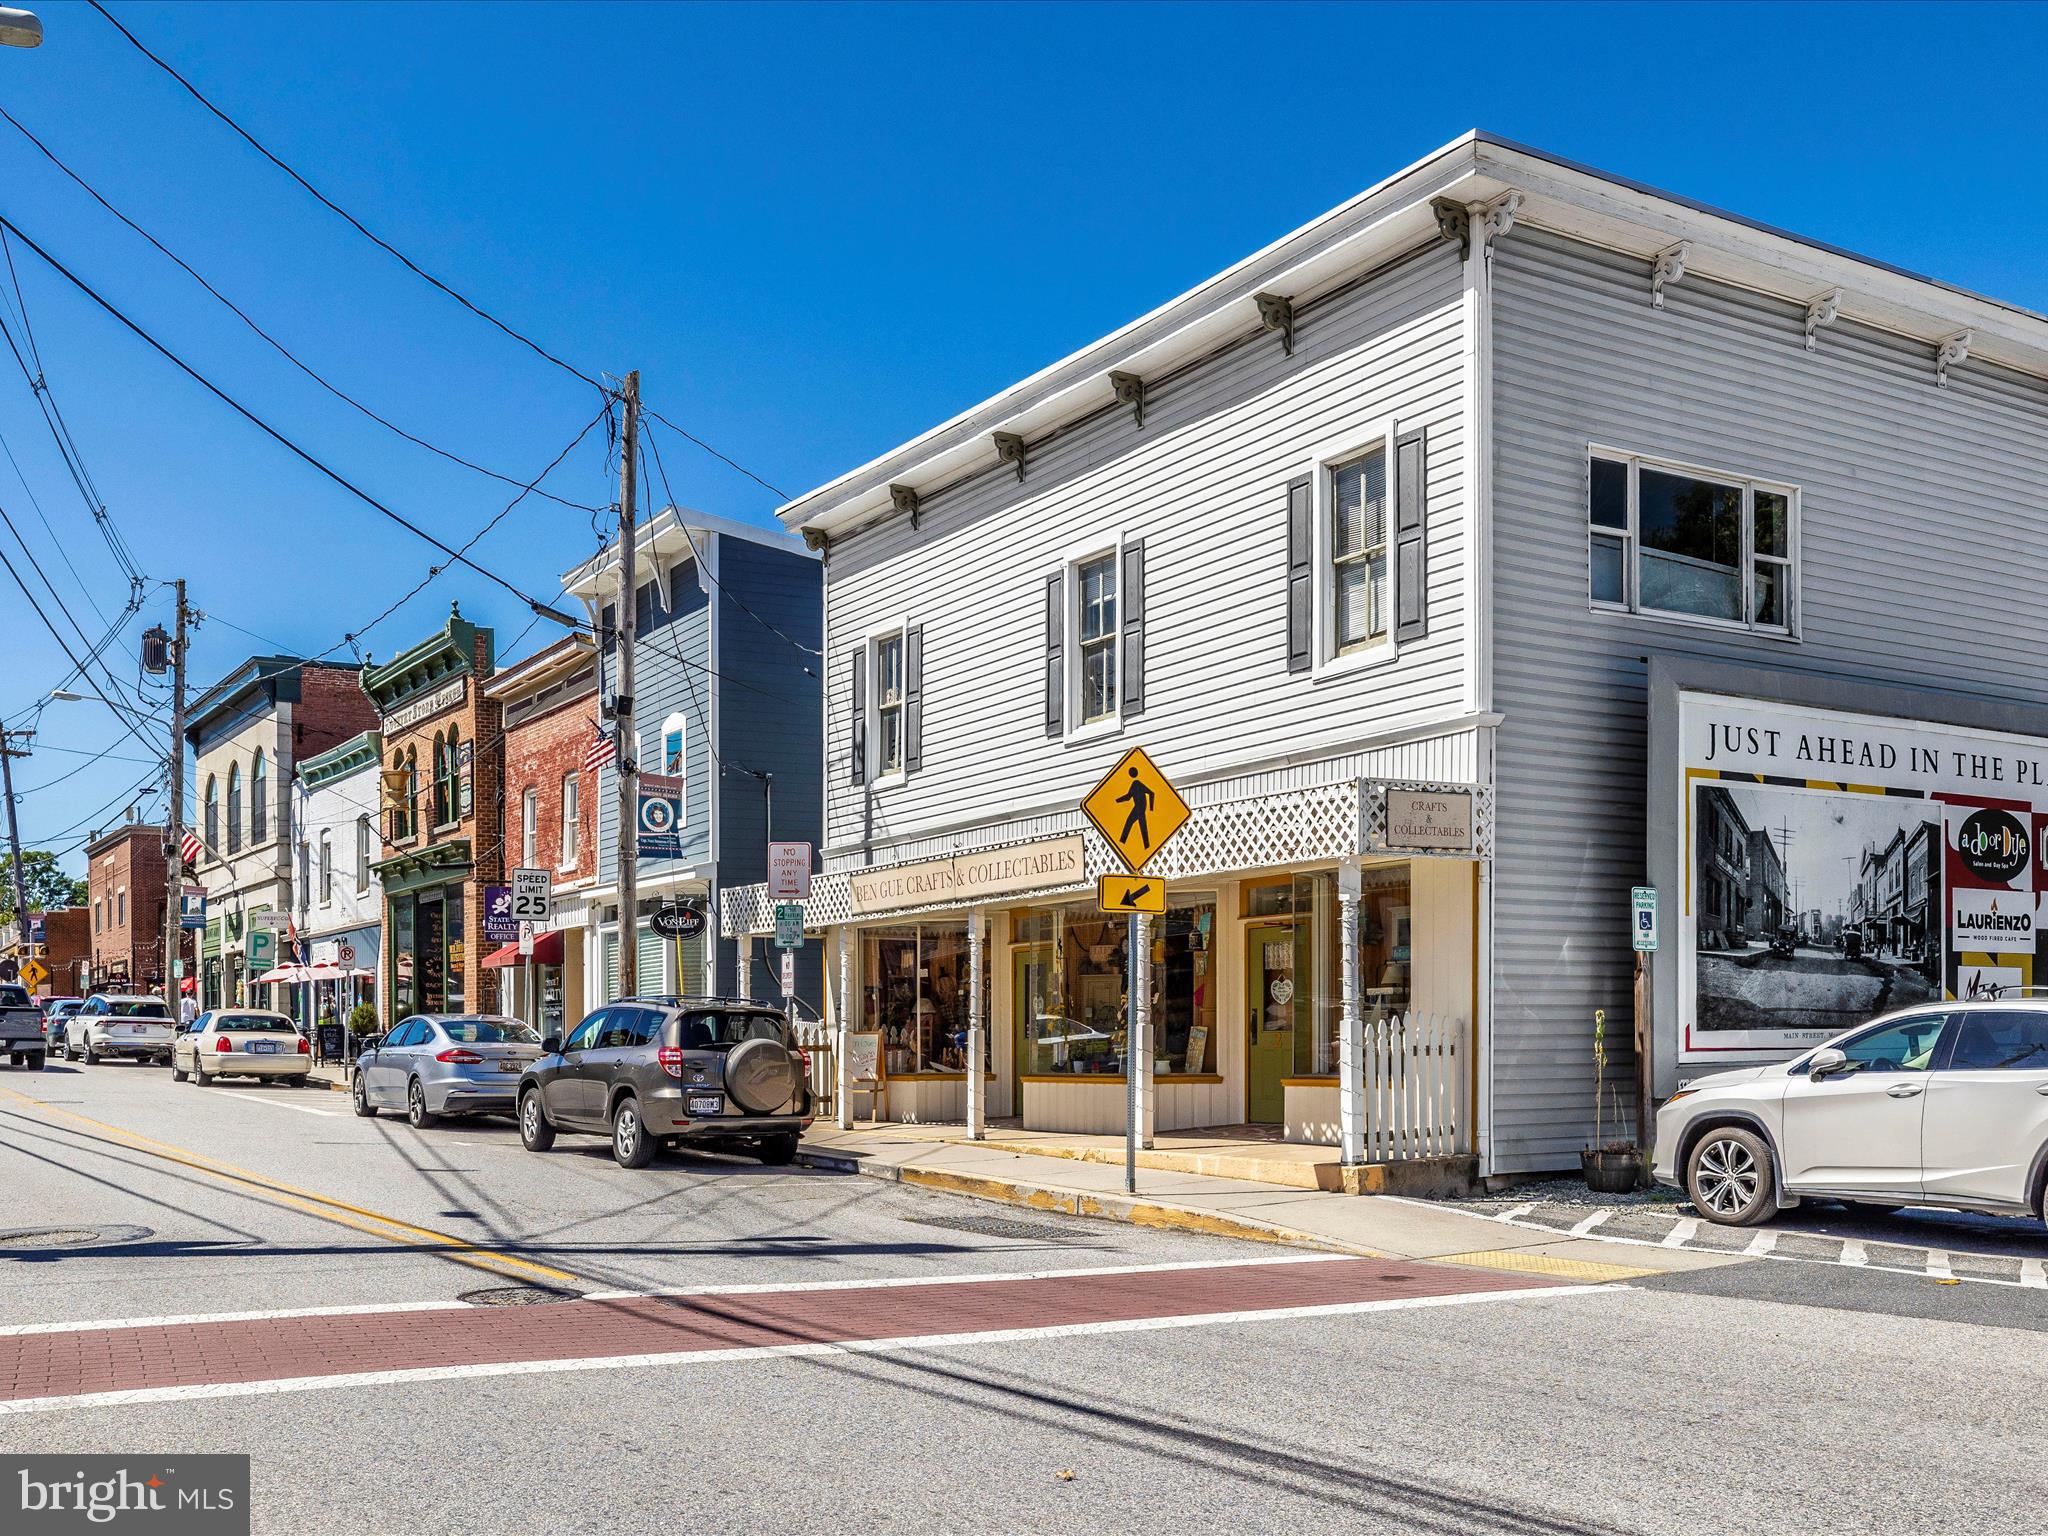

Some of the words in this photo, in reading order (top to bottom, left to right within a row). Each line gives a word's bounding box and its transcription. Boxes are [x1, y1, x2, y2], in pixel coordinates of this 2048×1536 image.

[1705, 723, 1781, 761] JUST
[1796, 734, 1897, 769] AHEAD
[1910, 747, 1940, 774] IN
[1952, 752, 2004, 781] THE
[2016, 759, 2048, 787] PL
[1411, 800, 1448, 812] CRAFTS
[1426, 814, 1433, 824] &
[1394, 825, 1465, 837] COLLECTABLES
[783, 848, 796, 856] NO
[773, 859, 806, 867] STOPPING
[2001, 862, 2009, 870] Spa
[517, 874, 548, 884] SPEED
[855, 884, 878, 903] BEN
[879, 878, 904, 899] GUE
[906, 870, 954, 895] CRAFTS
[956, 872, 965, 887] &
[968, 850, 1076, 884] COLLECTABLES
[519, 886, 544, 894] LIMIT
[515, 896, 547, 915] 25
[487, 922, 518, 931] REALTY
